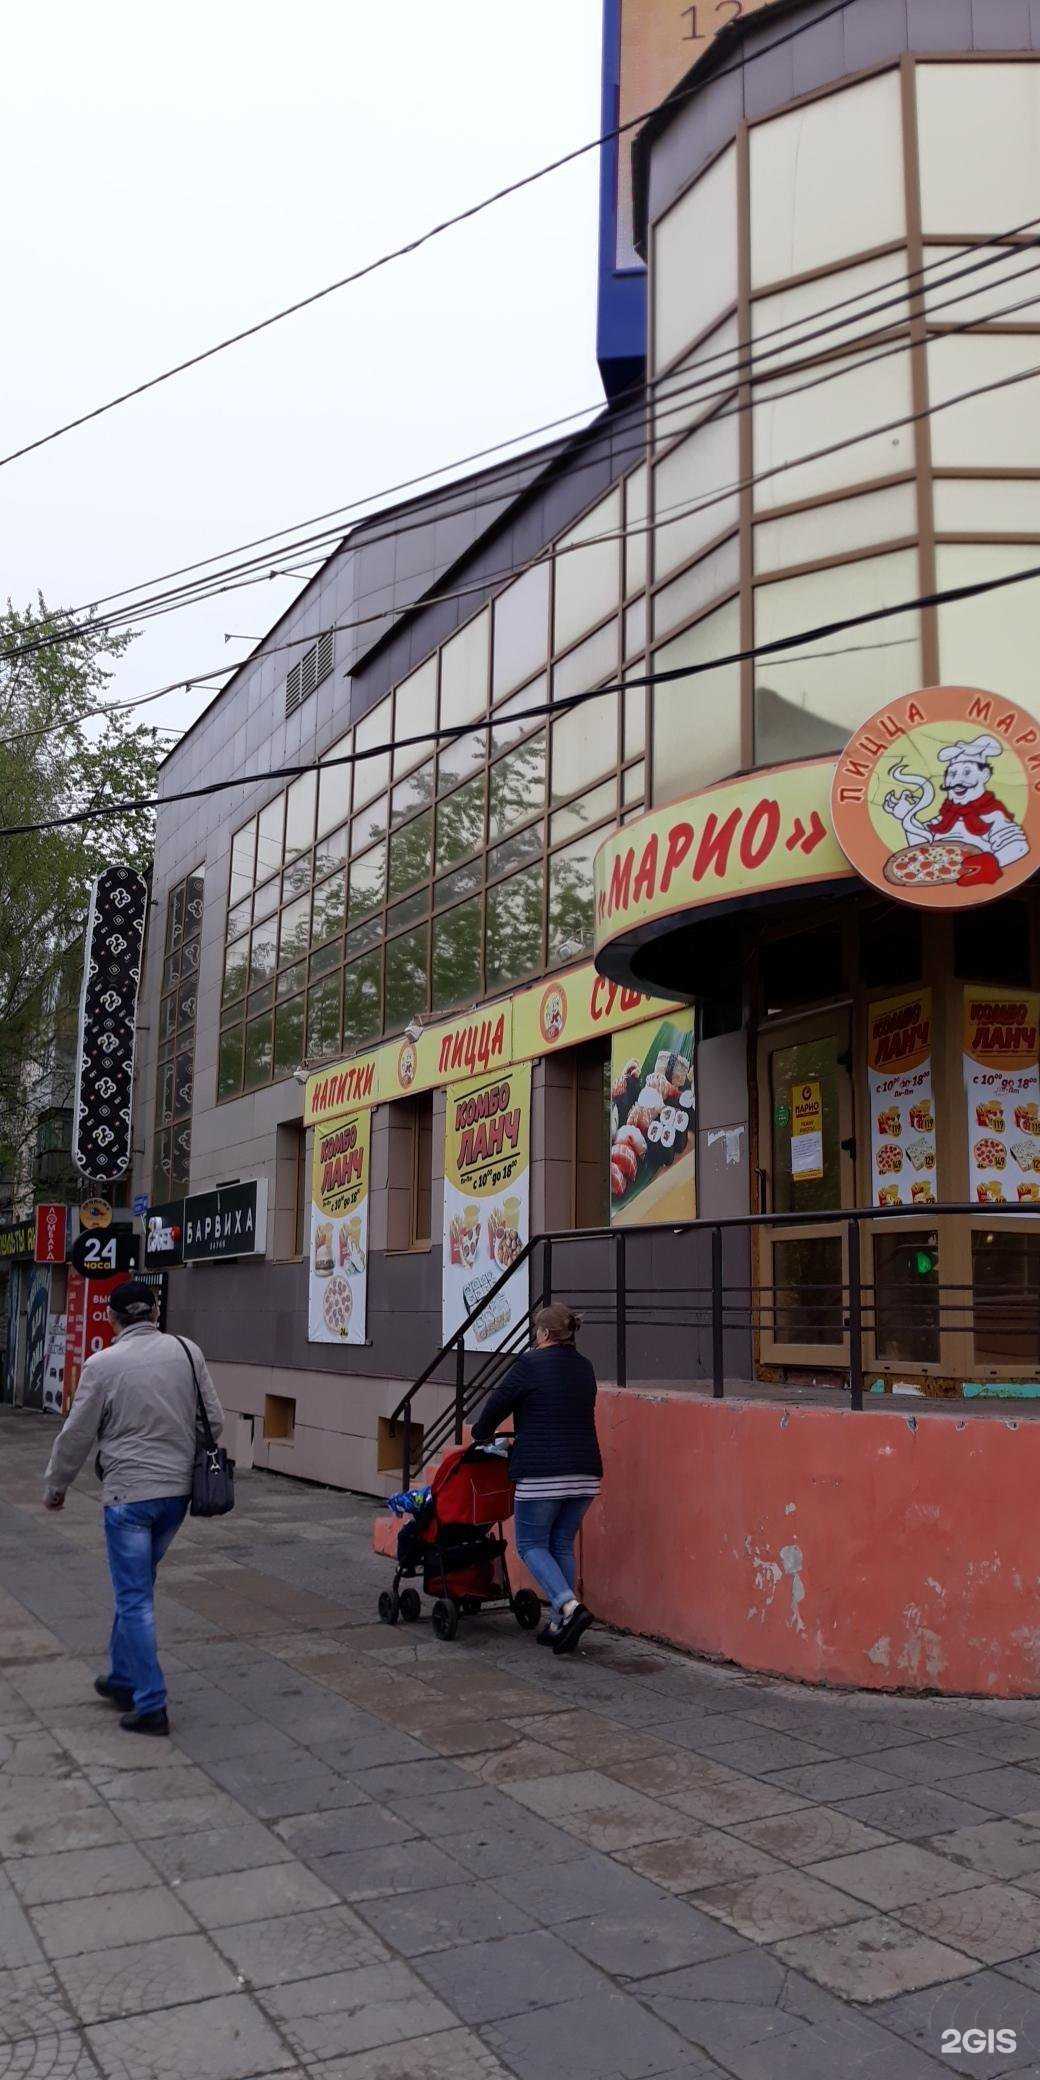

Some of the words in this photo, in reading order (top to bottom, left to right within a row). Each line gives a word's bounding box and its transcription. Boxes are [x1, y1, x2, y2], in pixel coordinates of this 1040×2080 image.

[840, 702, 925, 803] ПИЦЦА
[312, 1062, 376, 1114] НАПИТКИ
[439, 1013, 505, 1075] ПИЦЦА
[591, 974, 652, 1021] СУШ
[972, 1026, 1037, 1050] ЛАНЧ
[455, 1081, 511, 1131] КОМБО
[320, 1124, 358, 1164] КОМБО
[457, 1108, 521, 1170] ЛАНЧ
[321, 1147, 365, 1196] ЛАНЧ
[186, 1207, 254, 1244] БАРВИХА
[84, 1238, 117, 1270] 24
